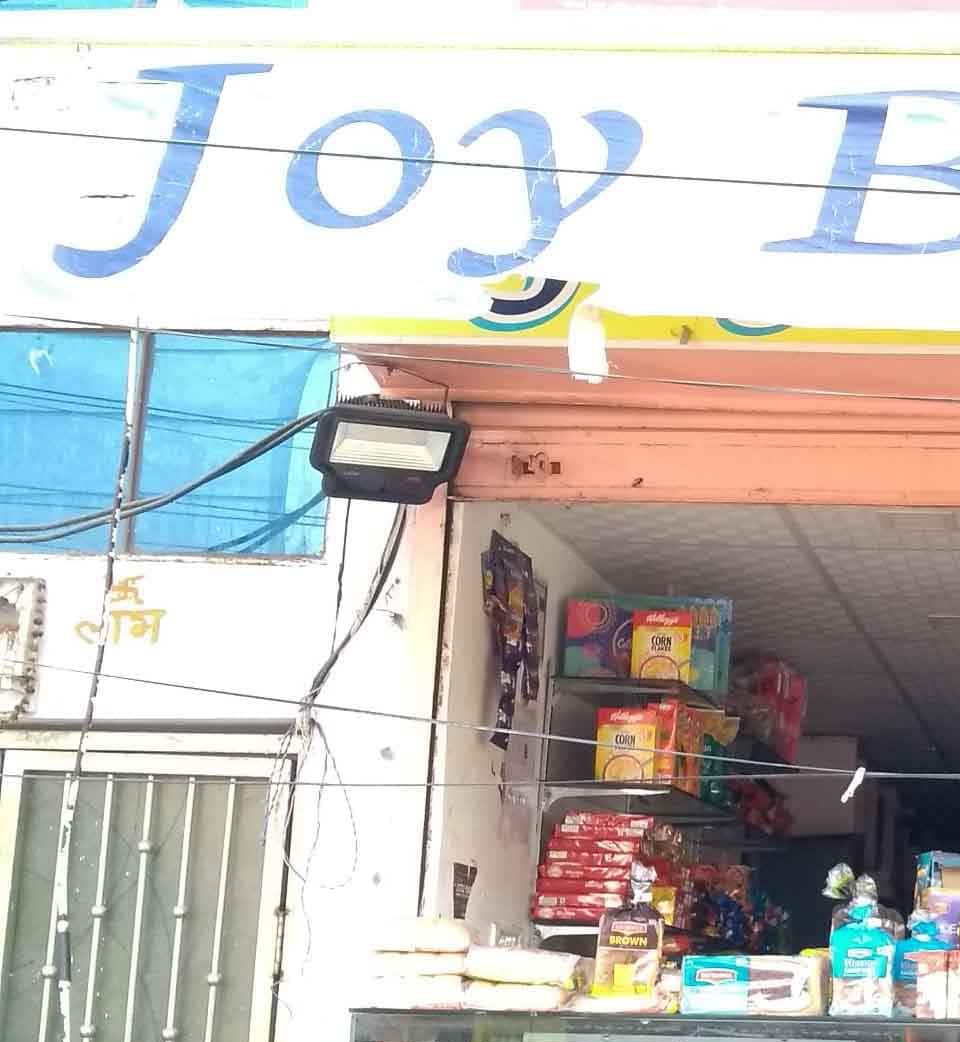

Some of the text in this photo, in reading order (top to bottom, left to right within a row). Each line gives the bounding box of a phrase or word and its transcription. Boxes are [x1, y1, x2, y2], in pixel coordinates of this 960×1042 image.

[53, 63, 644, 279] Joy
[651, 635, 673, 646] CORN
[615, 734, 636, 745] CORN
[608, 935, 648, 947] BROWN
